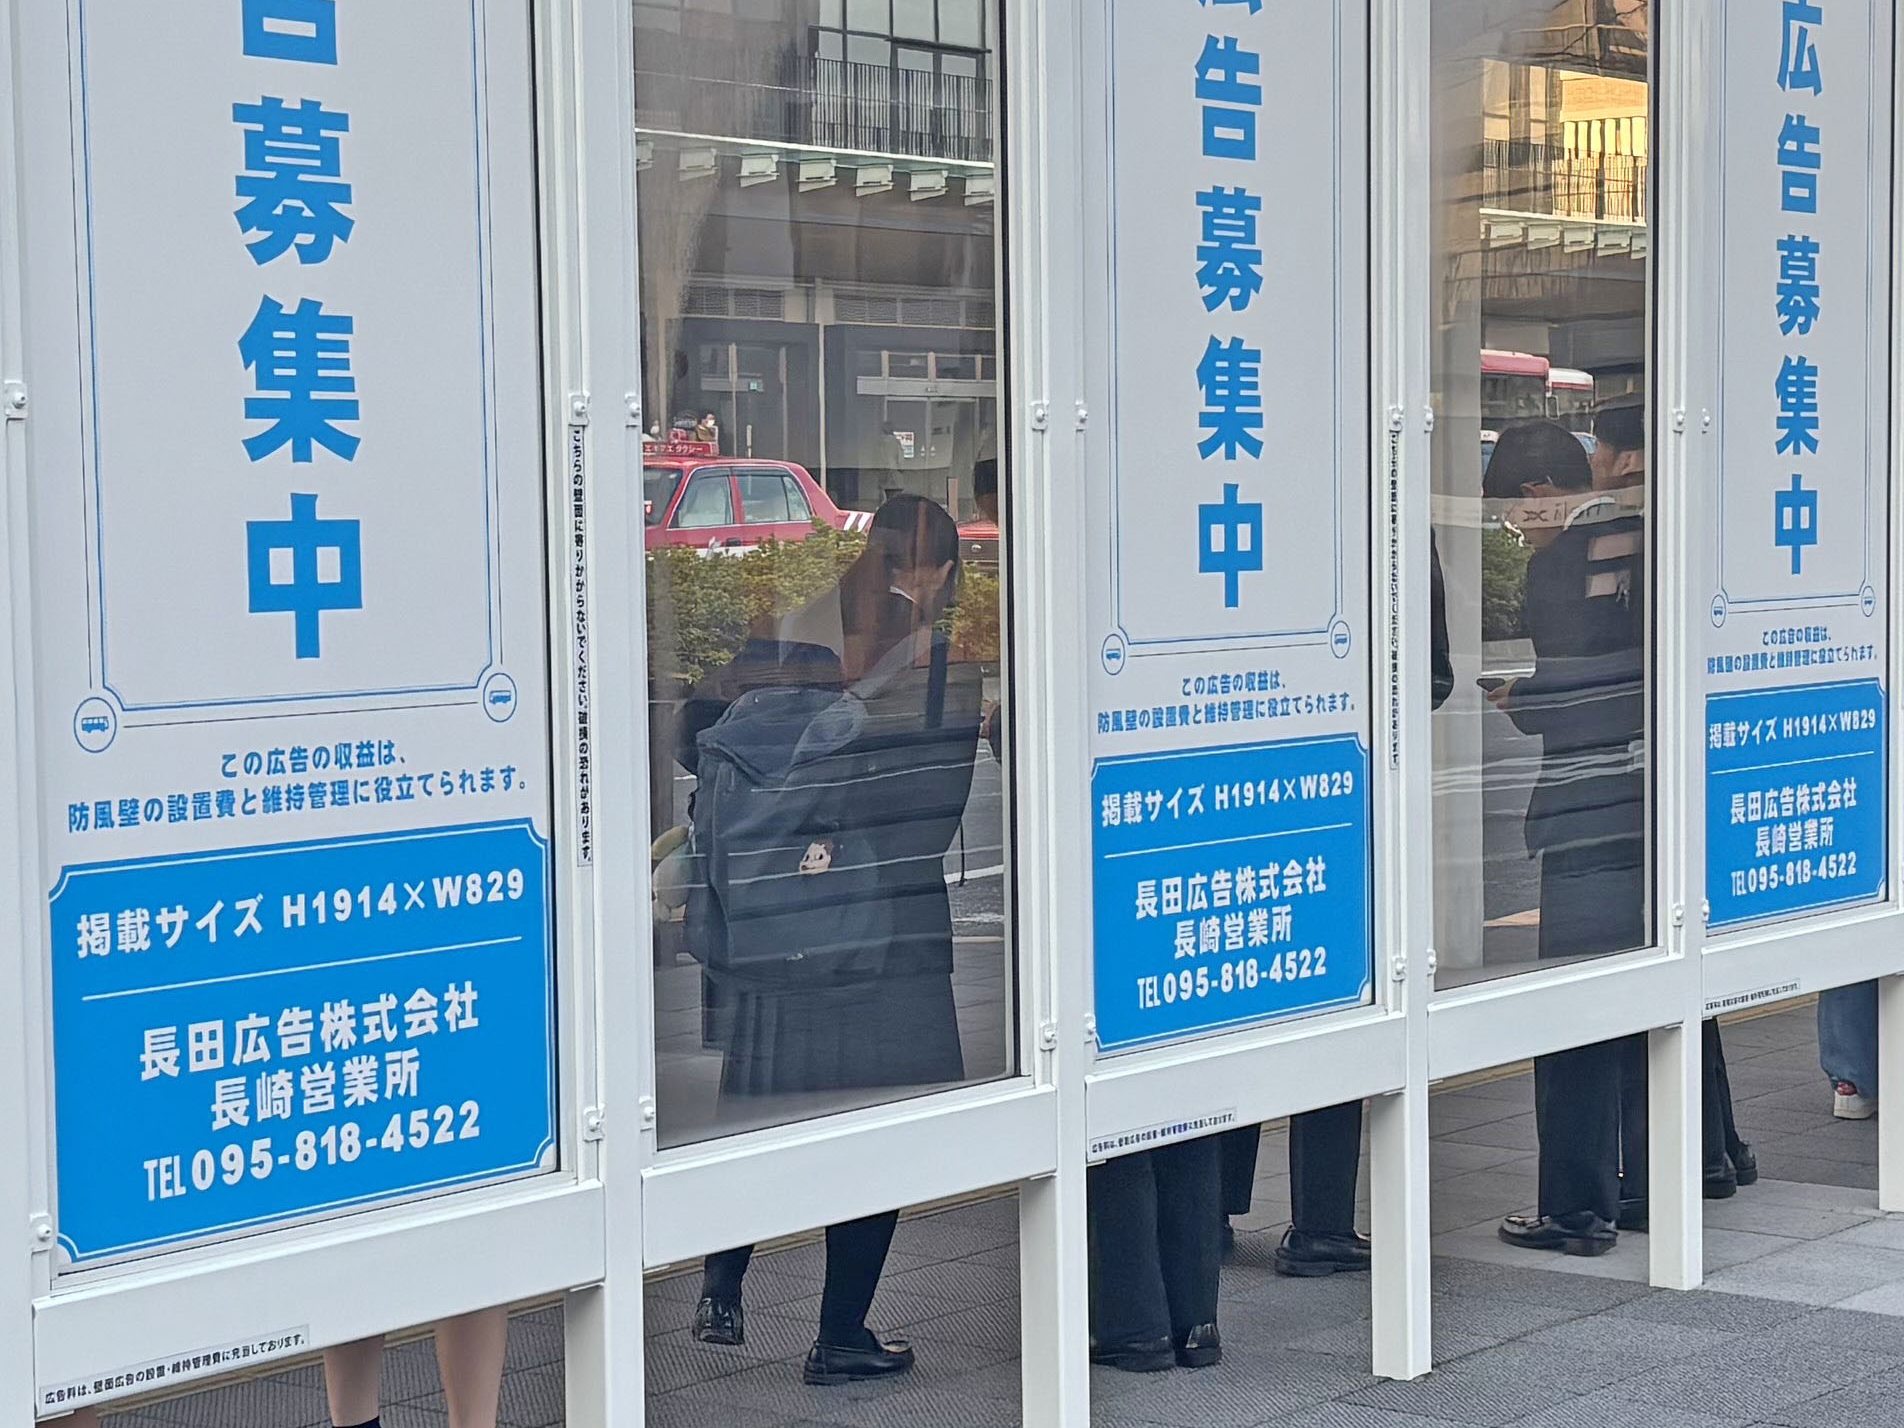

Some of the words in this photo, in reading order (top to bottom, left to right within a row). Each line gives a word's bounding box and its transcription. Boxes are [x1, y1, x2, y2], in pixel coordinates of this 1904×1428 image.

[1709, 715, 1778, 750] 掲載サイズ
[220, 740, 407, 780] この広告の収益は、
[67, 764, 527, 834] 防風壁の設置費と維持管理に役立てられます。
[1101, 784, 1205, 827] 掲載サイズ
[1730, 777, 1857, 825] 長田広告株式会社
[1755, 817, 1834, 858] 長崎営業所
[1135, 856, 1327, 920] 長田広告株式会社
[76, 893, 263, 959] 掲載サイズ
[1174, 907, 1292, 959] 長崎営業所
[139, 980, 480, 1083] 長田広告株式会社
[210, 1048, 421, 1132] 長崎営業所
